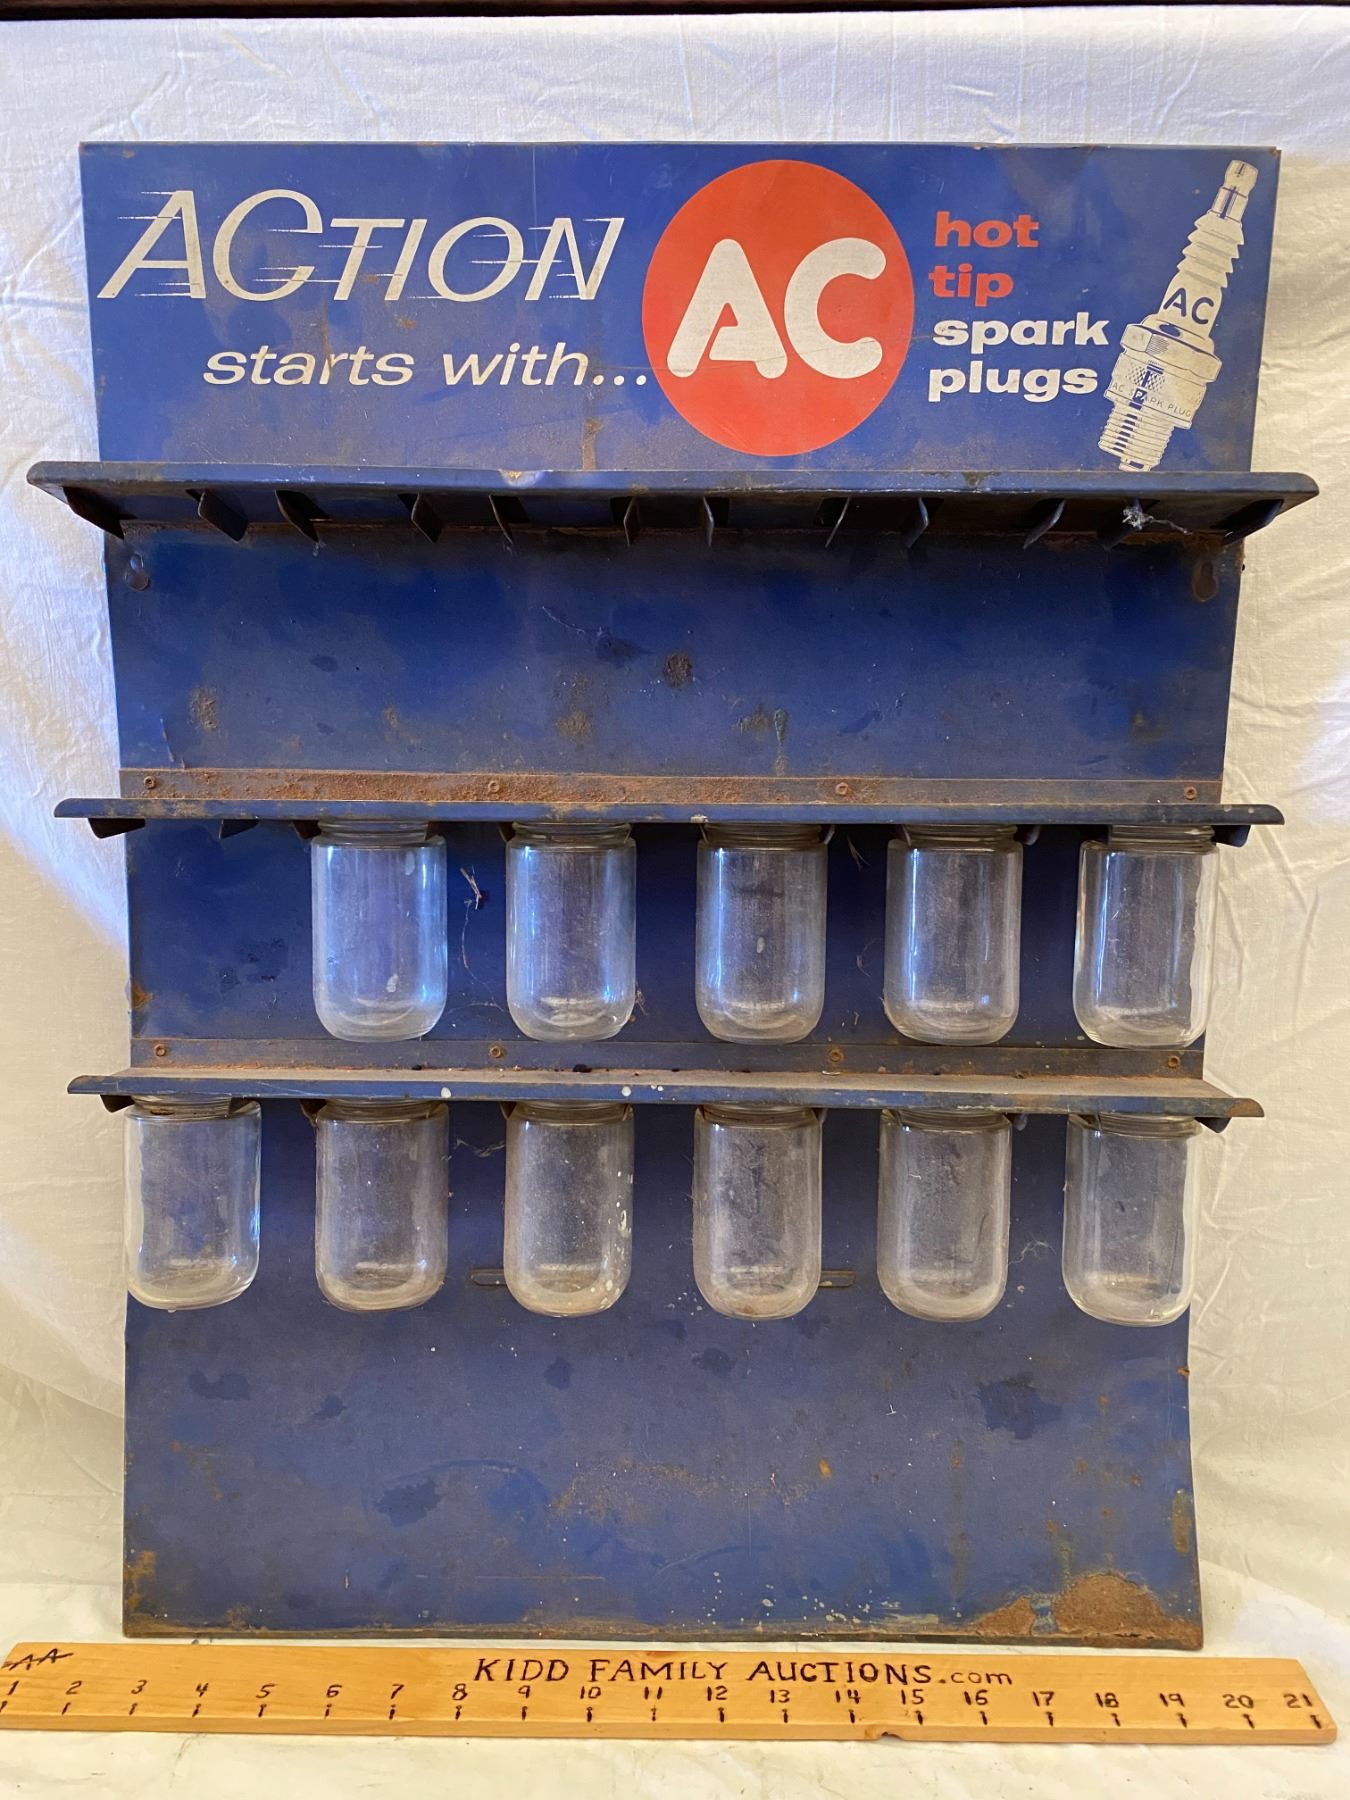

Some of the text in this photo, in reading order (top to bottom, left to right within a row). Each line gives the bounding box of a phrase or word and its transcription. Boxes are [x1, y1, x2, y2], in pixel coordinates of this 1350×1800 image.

[97, 188, 625, 303] ACTION
[935, 211, 1039, 248] hot
[929, 264, 1014, 307] tip
[1162, 286, 1215, 326] AC
[666, 237, 887, 380] AC
[932, 312, 1110, 355] spark
[202, 341, 648, 386] starts with...
[927, 360, 1099, 403] plugs
[473, 1658, 1013, 1685] KIDD FAMILY AUCTIONS.com
[65, 1680, 82, 1695] 2
[131, 1679, 147, 1695] 3
[196, 1682, 209, 1698] 4
[255, 1684, 276, 1699] 5
[326, 1684, 343, 1698] 6
[390, 1684, 405, 1700] 7
[451, 1683, 468, 1701] 8
[517, 1685, 531, 1699] 9
[579, 1685, 602, 1700] 10
[644, 1686, 663, 1701] 11
[706, 1685, 728, 1702] 12
[770, 1689, 791, 1704] 13
[835, 1689, 861, 1705] 14
[900, 1689, 925, 1705] 15
[963, 1689, 988, 1706] 16
[1032, 1691, 1055, 1707] 17
[1095, 1692, 1120, 1708] 18
[1159, 1693, 1185, 1708] 19
[1221, 1694, 1255, 1710] 20
[1283, 1693, 1314, 1708] 21
